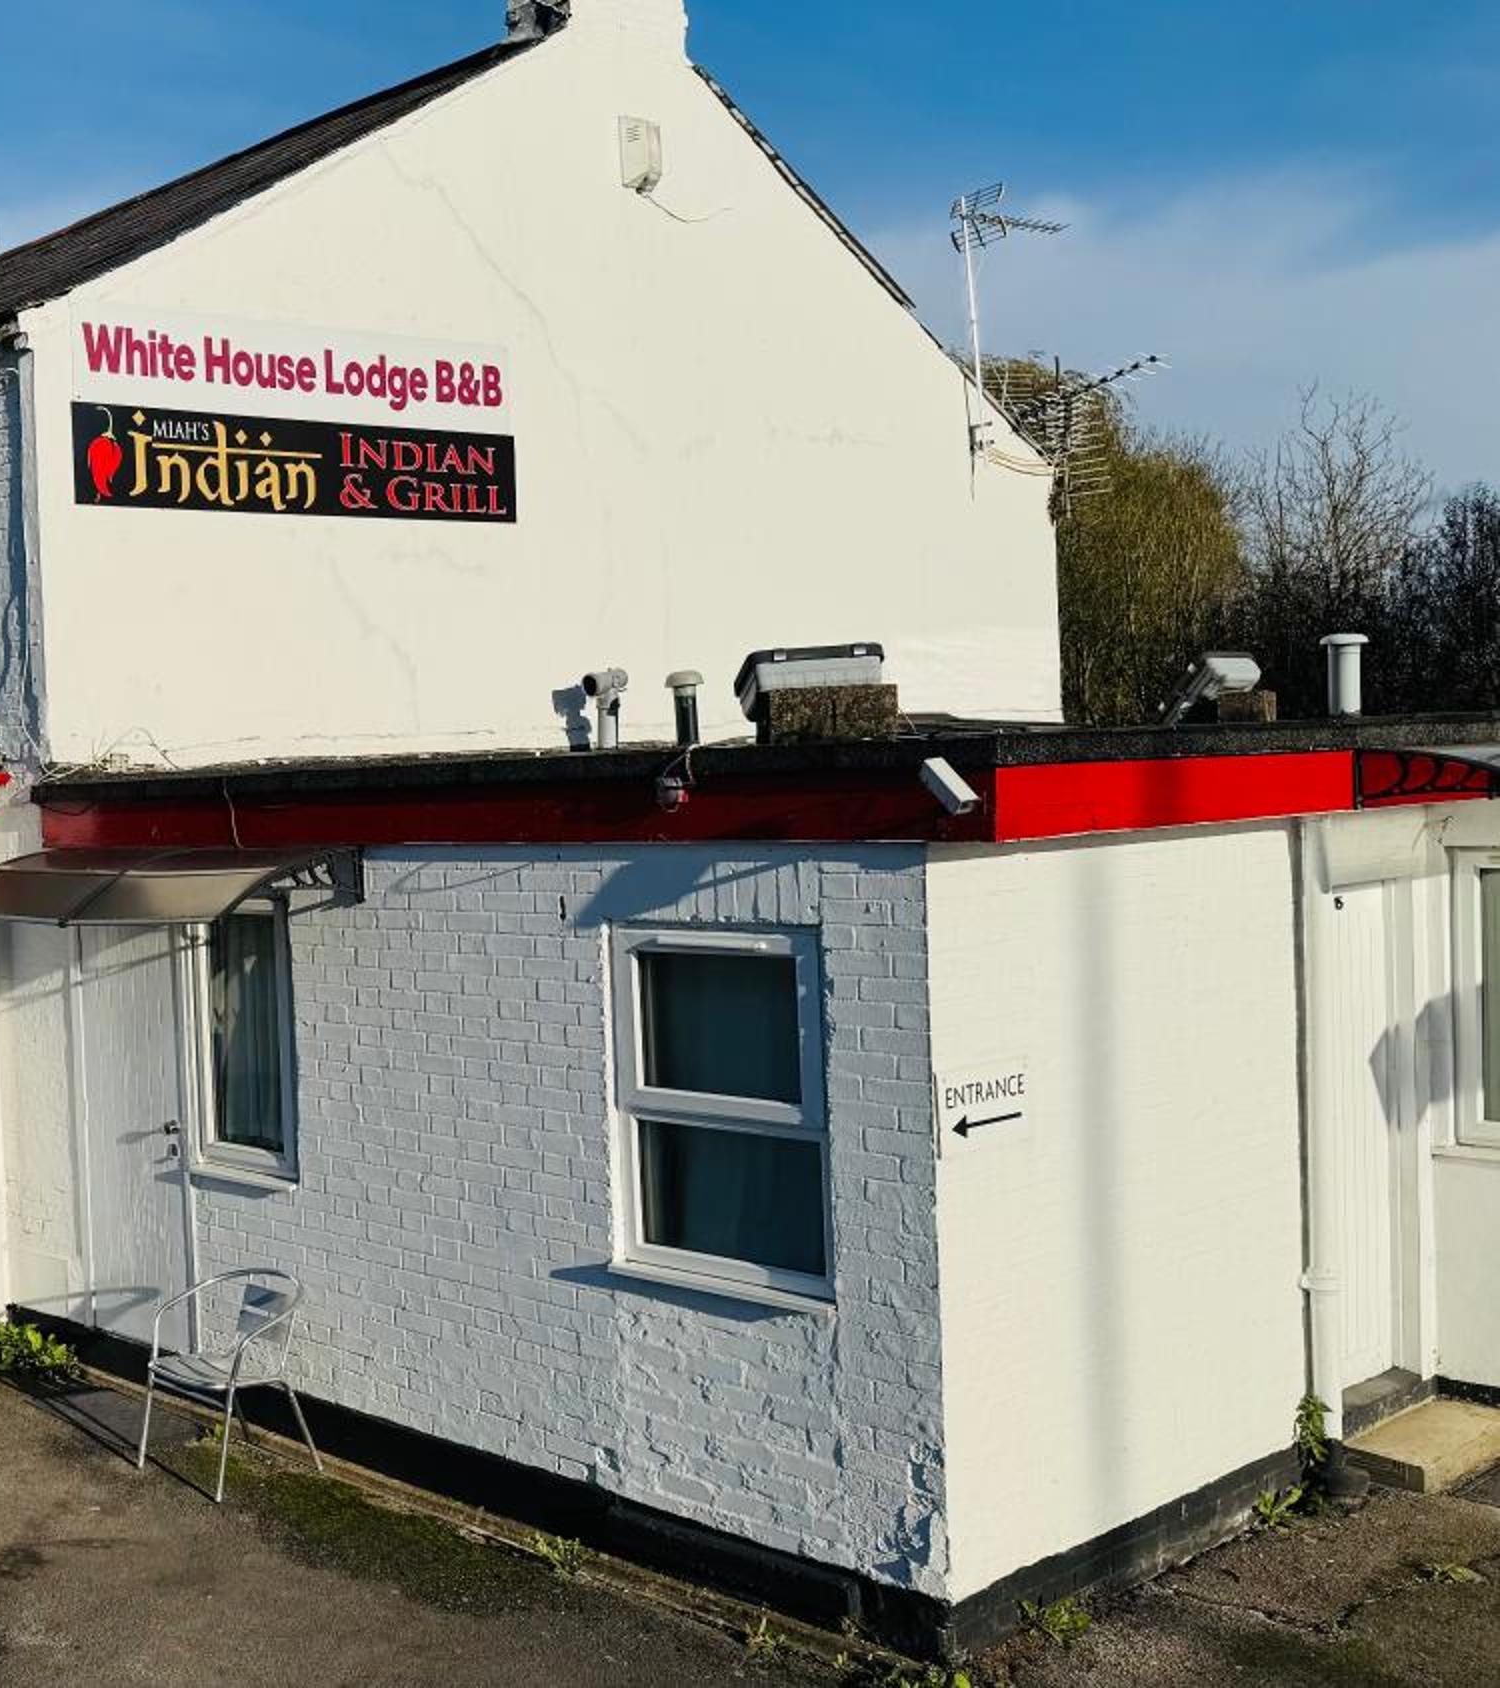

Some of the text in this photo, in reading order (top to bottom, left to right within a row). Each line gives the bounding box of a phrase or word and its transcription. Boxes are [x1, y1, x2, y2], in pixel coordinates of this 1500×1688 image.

[82, 322, 502, 411] White House Lodge B&B
[153, 420, 210, 441] MIAH'S
[339, 432, 496, 476] INDIAN
[339, 473, 507, 515] & GRILL
[945, 1073, 1025, 1109] ENTRANCE
